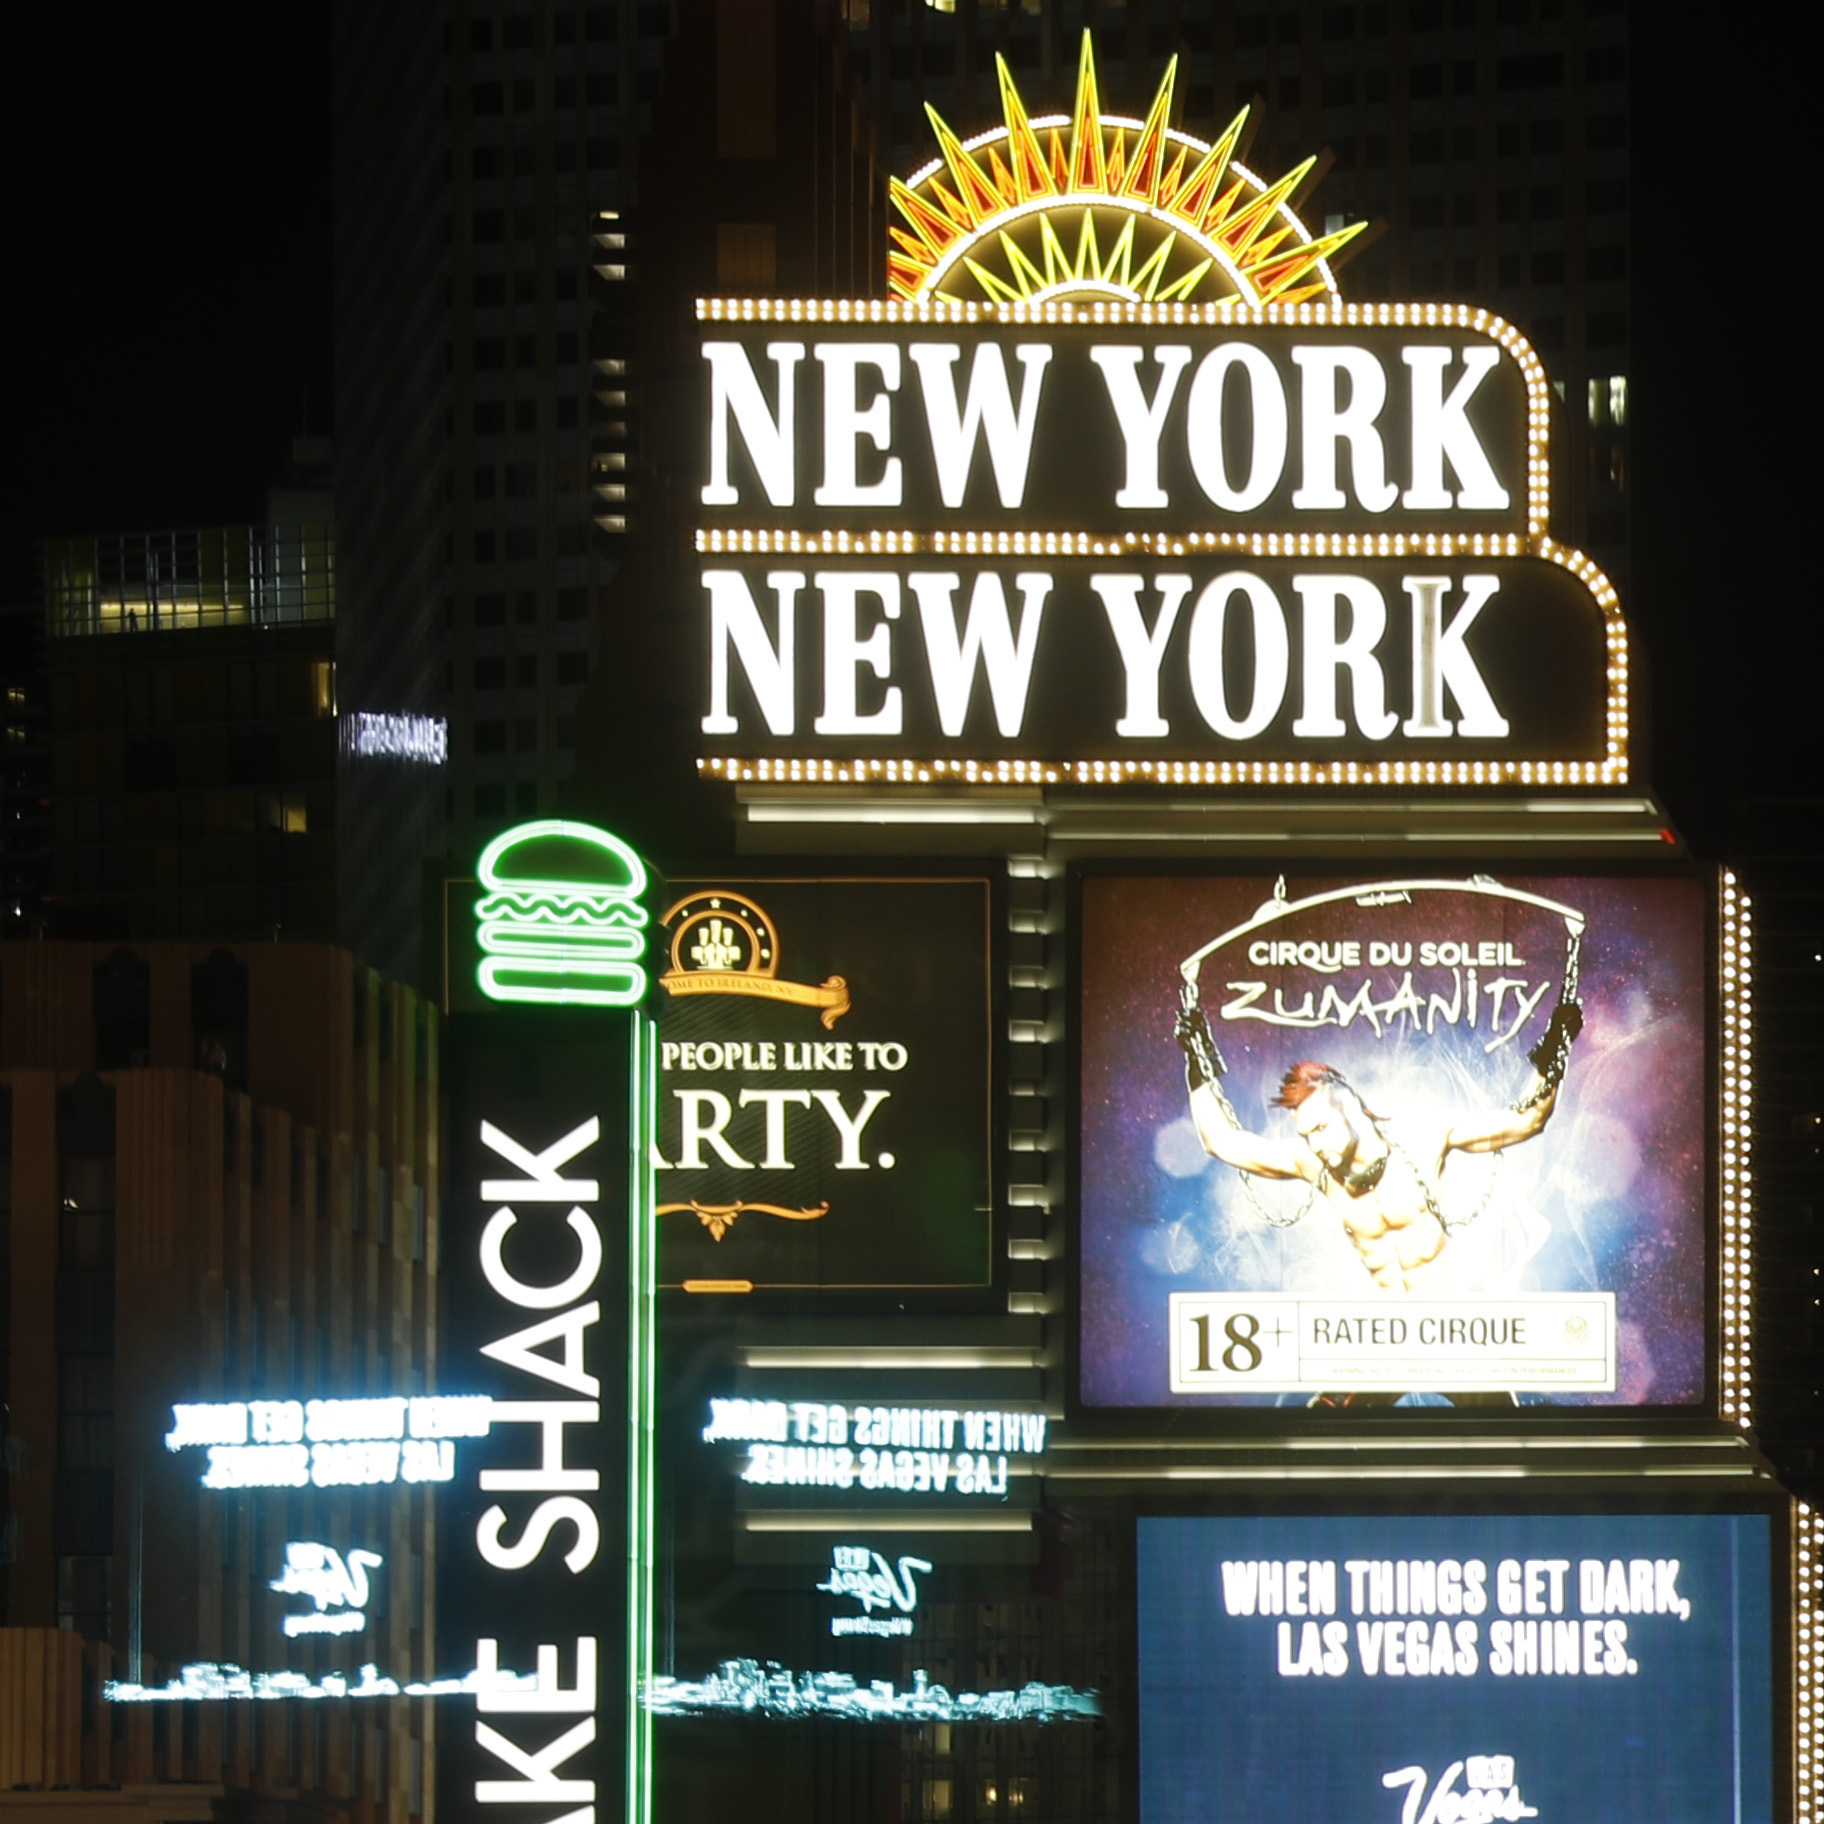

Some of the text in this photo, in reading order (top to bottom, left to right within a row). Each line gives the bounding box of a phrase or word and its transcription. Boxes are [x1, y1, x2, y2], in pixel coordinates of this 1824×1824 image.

[700, 342, 1510, 512] NEW YORK
[700, 571, 1510, 740] NEW YORK
[1248, 941, 1526, 973] CIRQUE DU SOLEIL
[661, 1042, 909, 1072] PEOPLE LIKE TO
[475, 1114, 602, 1575] SHACK
[1189, 1312, 1527, 1373] 18+ RATED CIRQUE
[1221, 1559, 1691, 1621] WHEN THINGS GET DARK,
[1277, 1620, 1639, 1678] LAS VEGAS SHINES.
